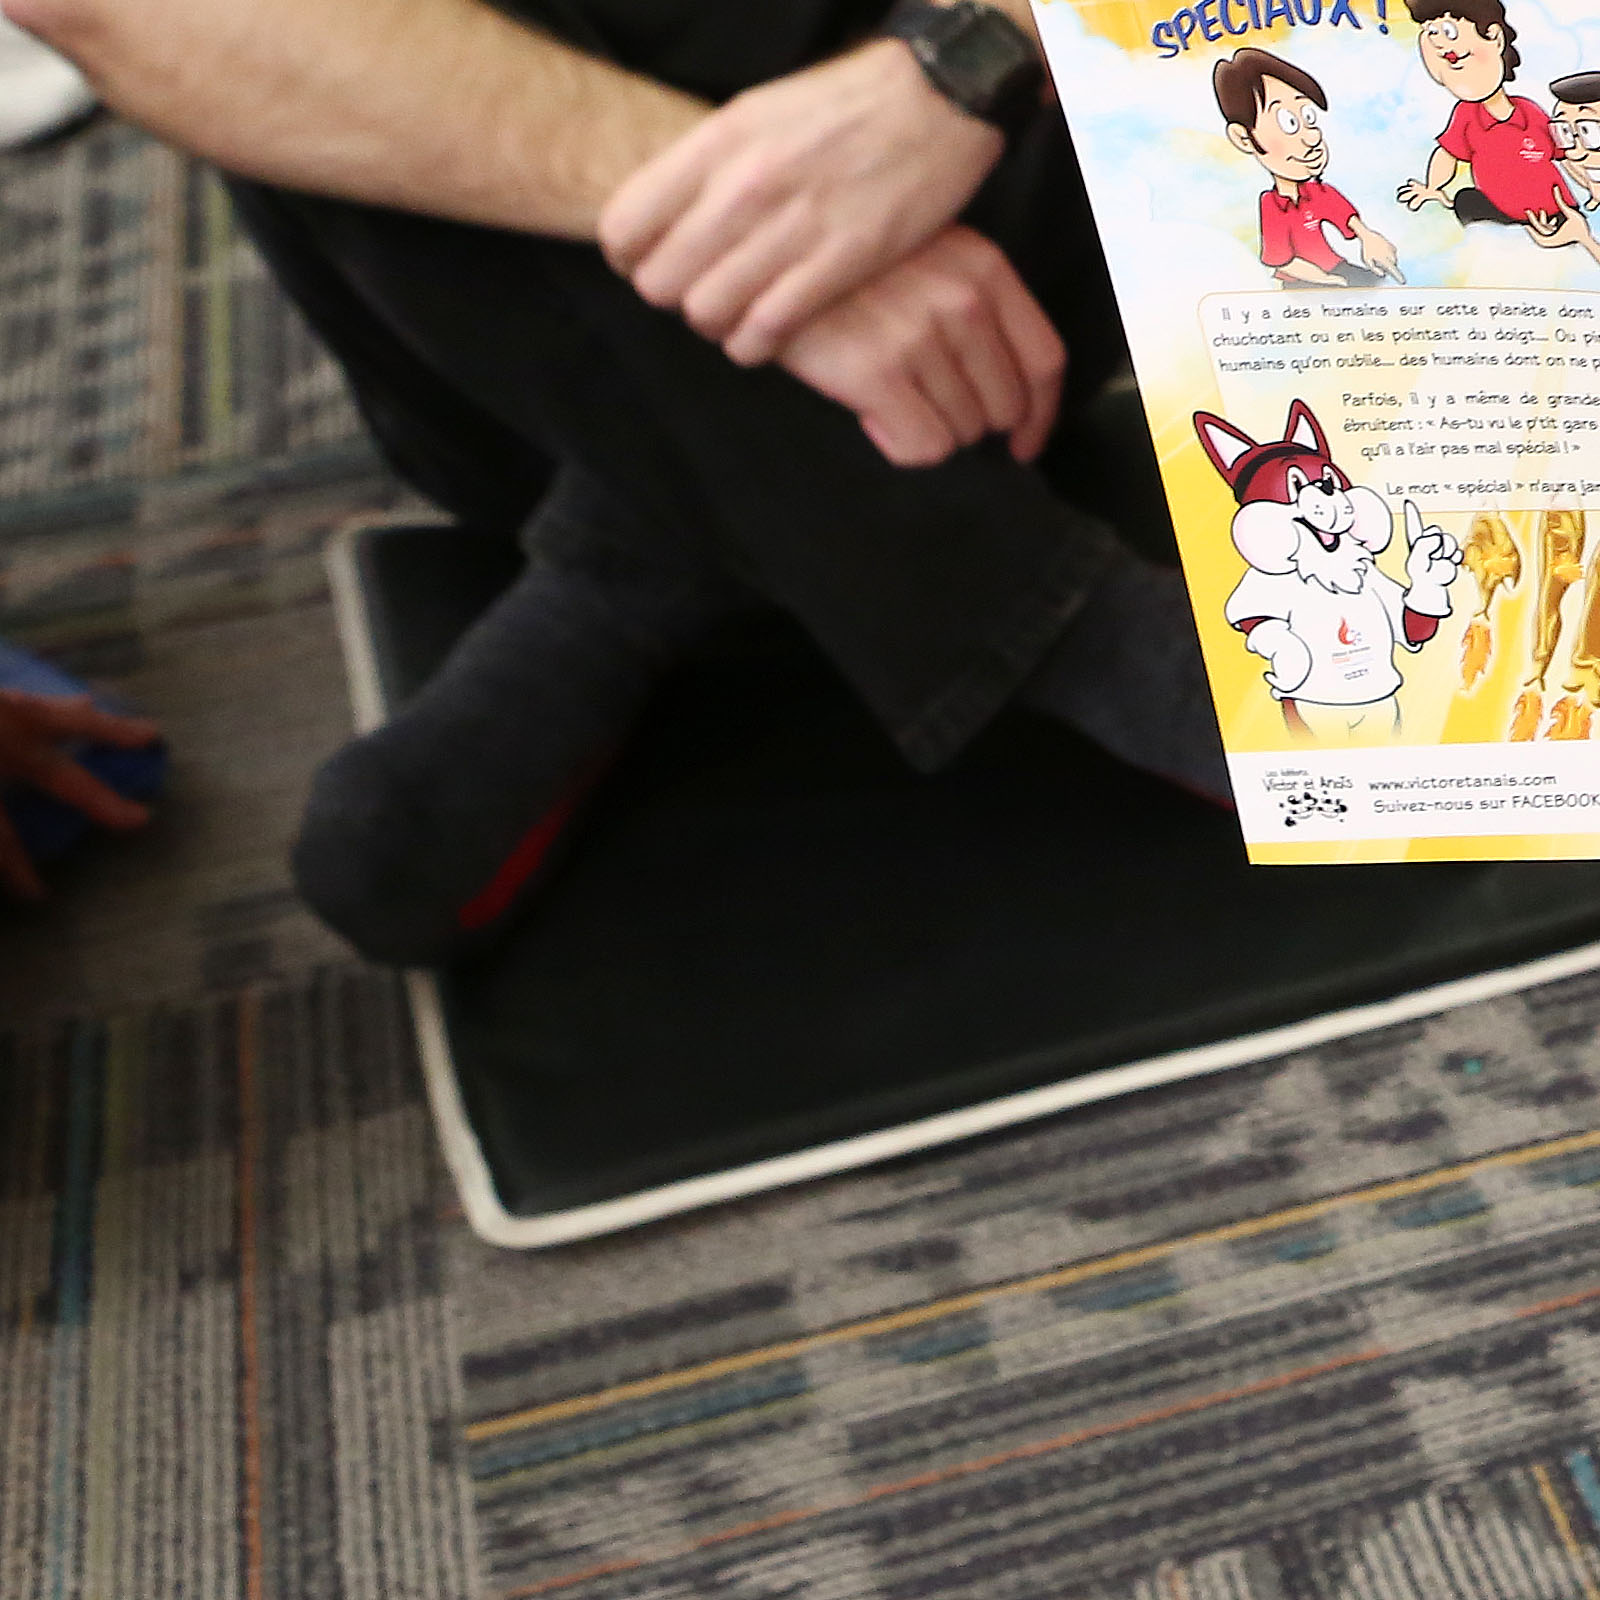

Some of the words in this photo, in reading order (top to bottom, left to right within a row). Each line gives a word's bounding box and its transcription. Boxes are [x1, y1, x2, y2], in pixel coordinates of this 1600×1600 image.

[1241, 309, 1251, 324] y
[1262, 308, 1271, 319] a
[1283, 305, 1311, 319] des
[1322, 303, 1389, 318] humains
[1399, 304, 1425, 316] sur
[1437, 303, 1480, 316] cette
[1489, 302, 1548, 319] planète
[1558, 304, 1594, 319] dont
[1213, 328, 1303, 348] chuchotant
[1310, 330, 1329, 343] ou
[1336, 331, 1356, 343] en
[1361, 328, 1385, 343] les
[1392, 327, 1460, 346] pointant
[1467, 327, 1487, 341] du
[1555, 328, 1577, 343] Ou
[1218, 357, 1285, 373] humains
[1291, 355, 1332, 374] qu'on
[1399, 353, 1428, 367] des
[1432, 352, 1499, 367] humains
[1504, 351, 1541, 367] dont
[1546, 355, 1566, 367] on
[1569, 356, 1588, 368] ne
[1341, 392, 1403, 408] Parfois,
[1426, 394, 1437, 409] y
[1446, 394, 1456, 405] a
[1465, 390, 1511, 405] même
[1519, 393, 1539, 405] de
[1343, 417, 1415, 433] ébruitent
[1440, 416, 1485, 430] As-tu
[1488, 419, 1505, 430] vu
[1510, 417, 1523, 430] le
[1563, 418, 1598, 433] gars
[1395, 445, 1405, 456] a
[1440, 444, 1470, 458] pas
[1474, 441, 1503, 455] mal
[1506, 440, 1560, 458] spécial
[1386, 482, 1404, 496] Le
[1408, 482, 1440, 495] mot
[1457, 479, 1511, 497] spécial
[1529, 479, 1577, 494] n'aura
[1368, 773, 1558, 793] www.victoretanais.com
[1374, 798, 1474, 814] Suivez-nous
[1480, 797, 1507, 811] sur
